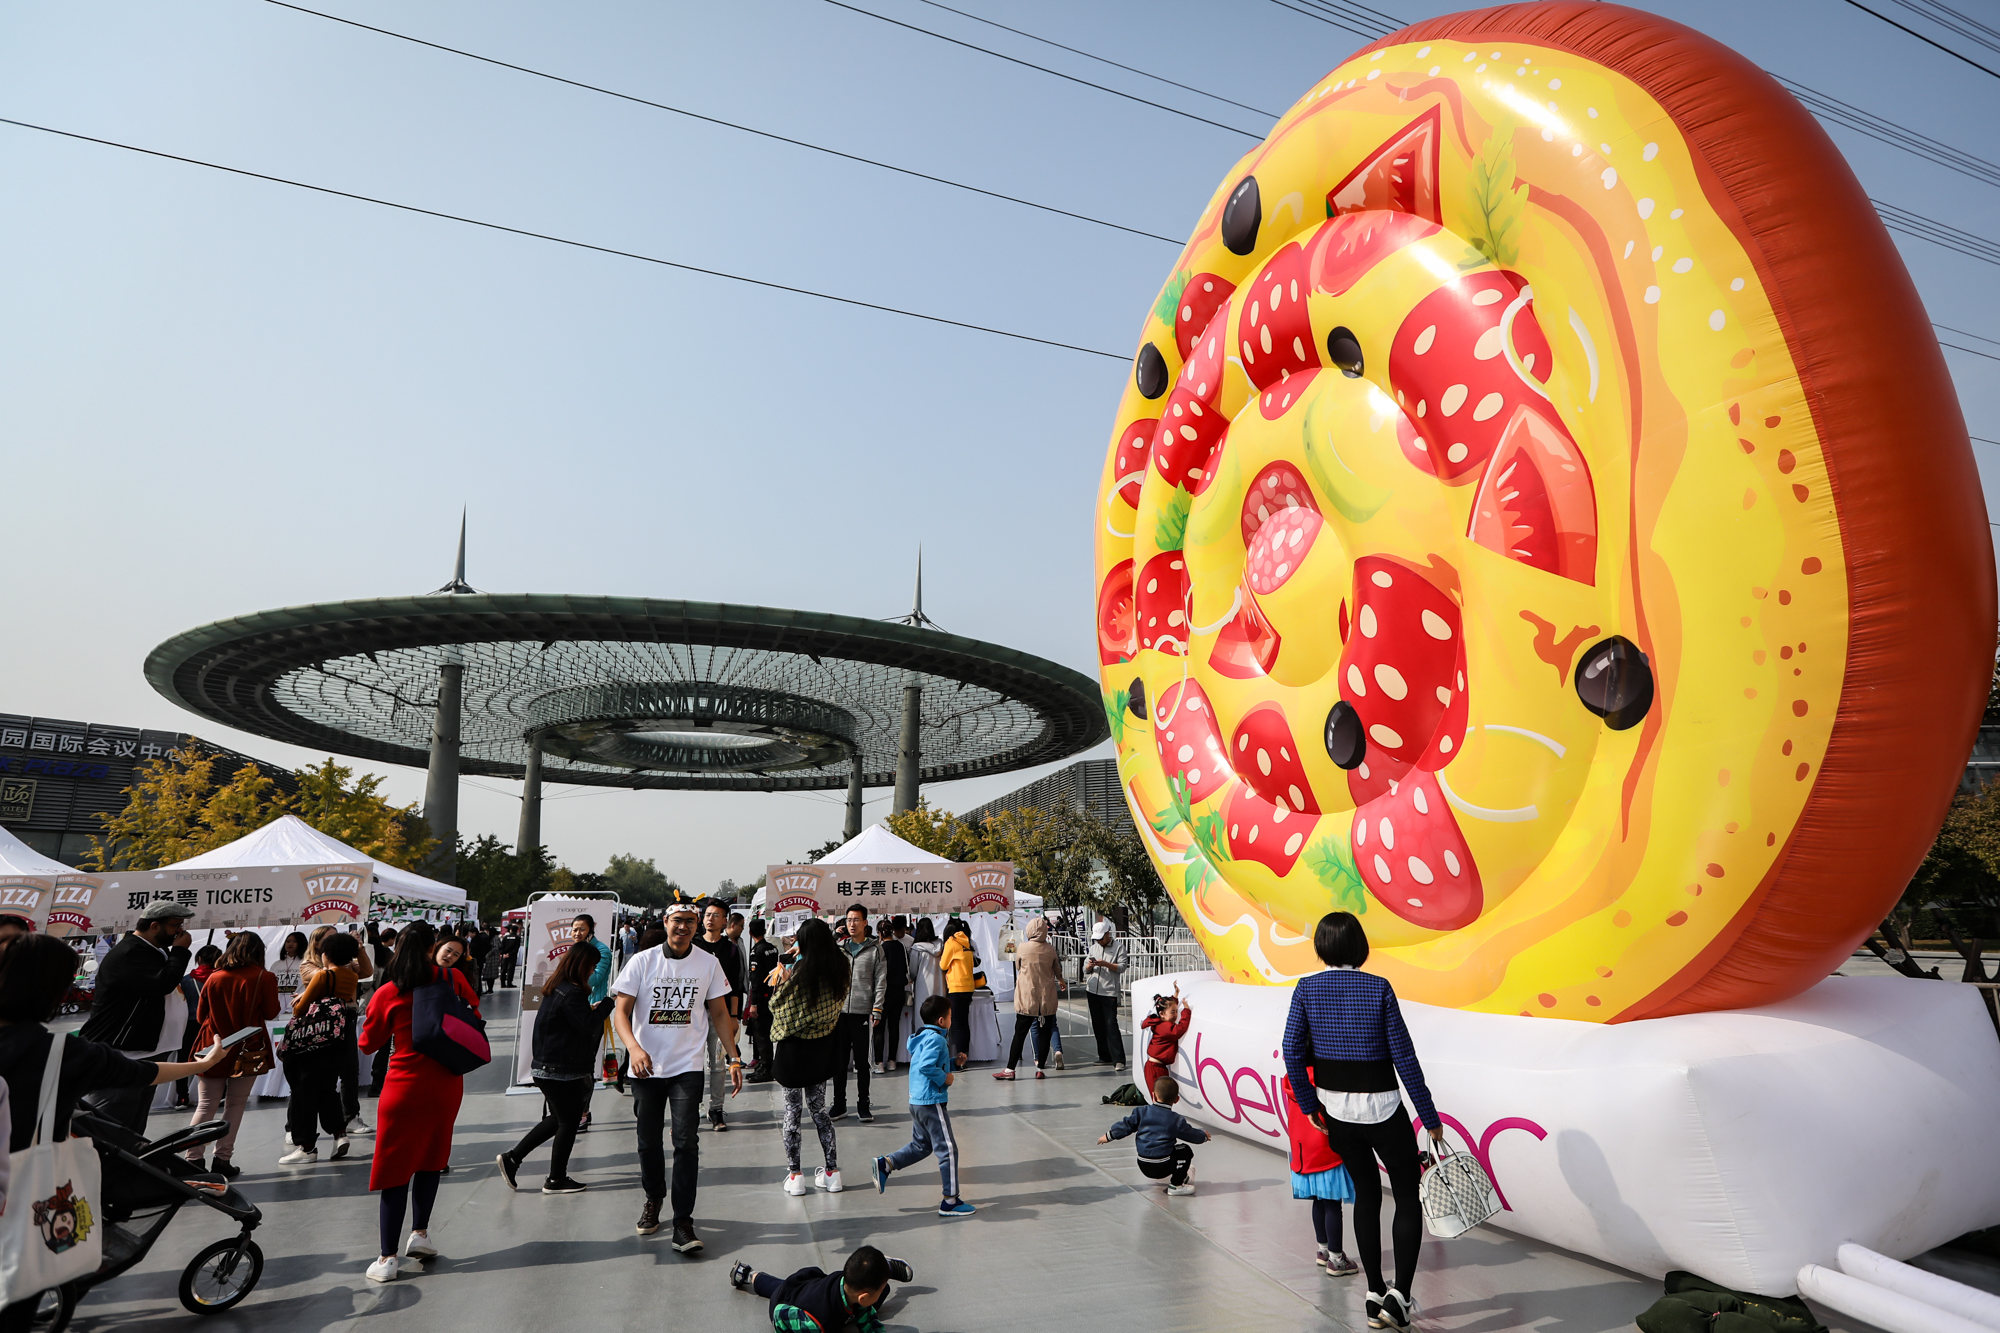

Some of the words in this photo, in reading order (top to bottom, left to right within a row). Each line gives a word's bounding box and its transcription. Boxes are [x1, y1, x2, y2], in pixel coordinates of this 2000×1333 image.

[23, 758, 110, 778] Plaza
[1, 805, 27, 813] YITEL
[306, 876, 360, 895] PIZZA
[775, 875, 818, 892] PIZZA
[837, 880, 887, 896] 电子票
[892, 880, 953, 894] E-TICKETS
[969, 872, 1006, 889] PIZZA
[0, 888, 40, 909] ZZA
[206, 887, 273, 905] TICKETS
[777, 897, 815, 909] FESTIVAL
[971, 893, 1005, 905] FESTIVAL
[307, 900, 353, 915] FESTIVAL
[551, 926, 572, 942] PIZ
[652, 986, 699, 999] STAFF
[651, 998, 695, 1010] 工作人员
[291, 1020, 331, 1040] MIAMI
